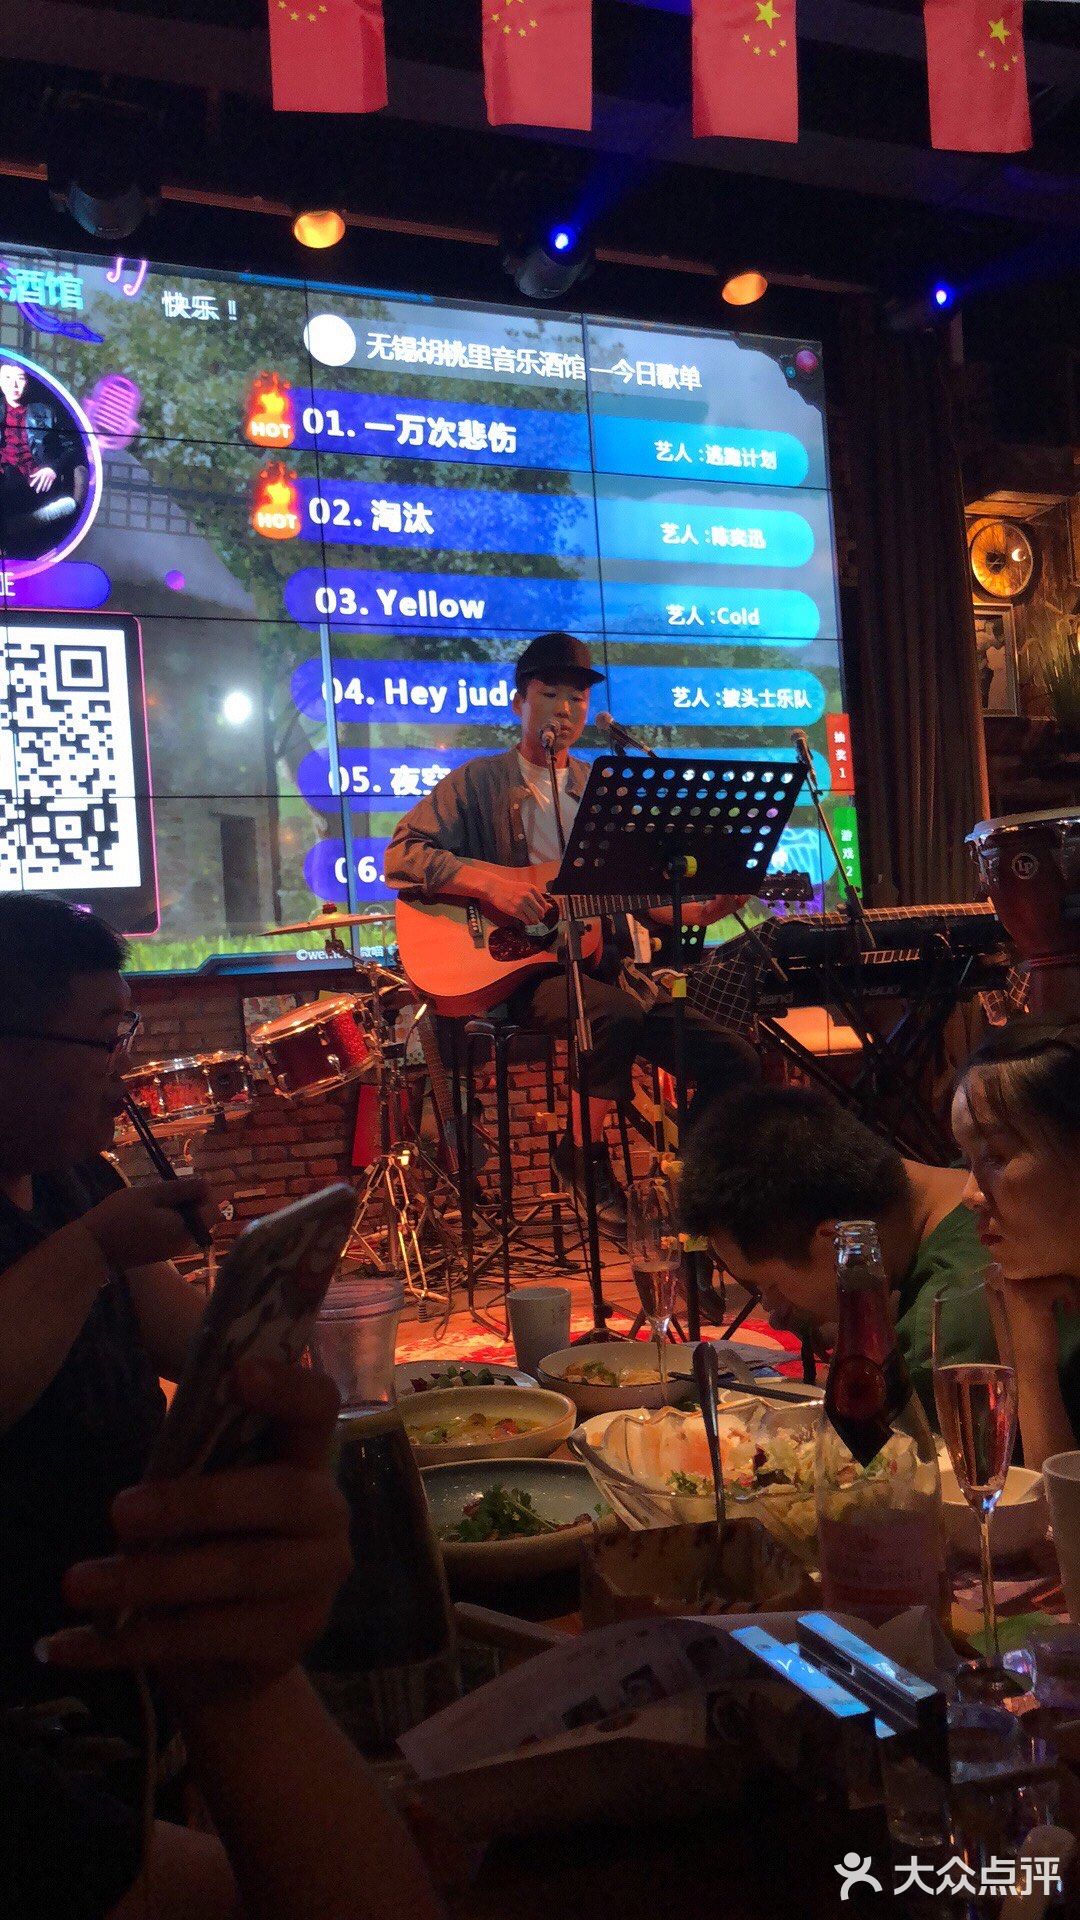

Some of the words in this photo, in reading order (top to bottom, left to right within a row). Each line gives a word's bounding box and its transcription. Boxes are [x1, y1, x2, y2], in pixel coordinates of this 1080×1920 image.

[0, 268, 84, 310] 酒馆
[251, 421, 291, 439] HOT
[302, 408, 356, 437] 01.
[364, 413, 517, 454] 一万次悲伤
[257, 512, 298, 529] HOT
[308, 497, 363, 527] 02.
[370, 499, 435, 535] 淘汰
[314, 587, 369, 615] 03.
[376, 588, 485, 619] Yellow
[384, 678, 447, 714] Hey
[456, 679, 517, 714] jud
